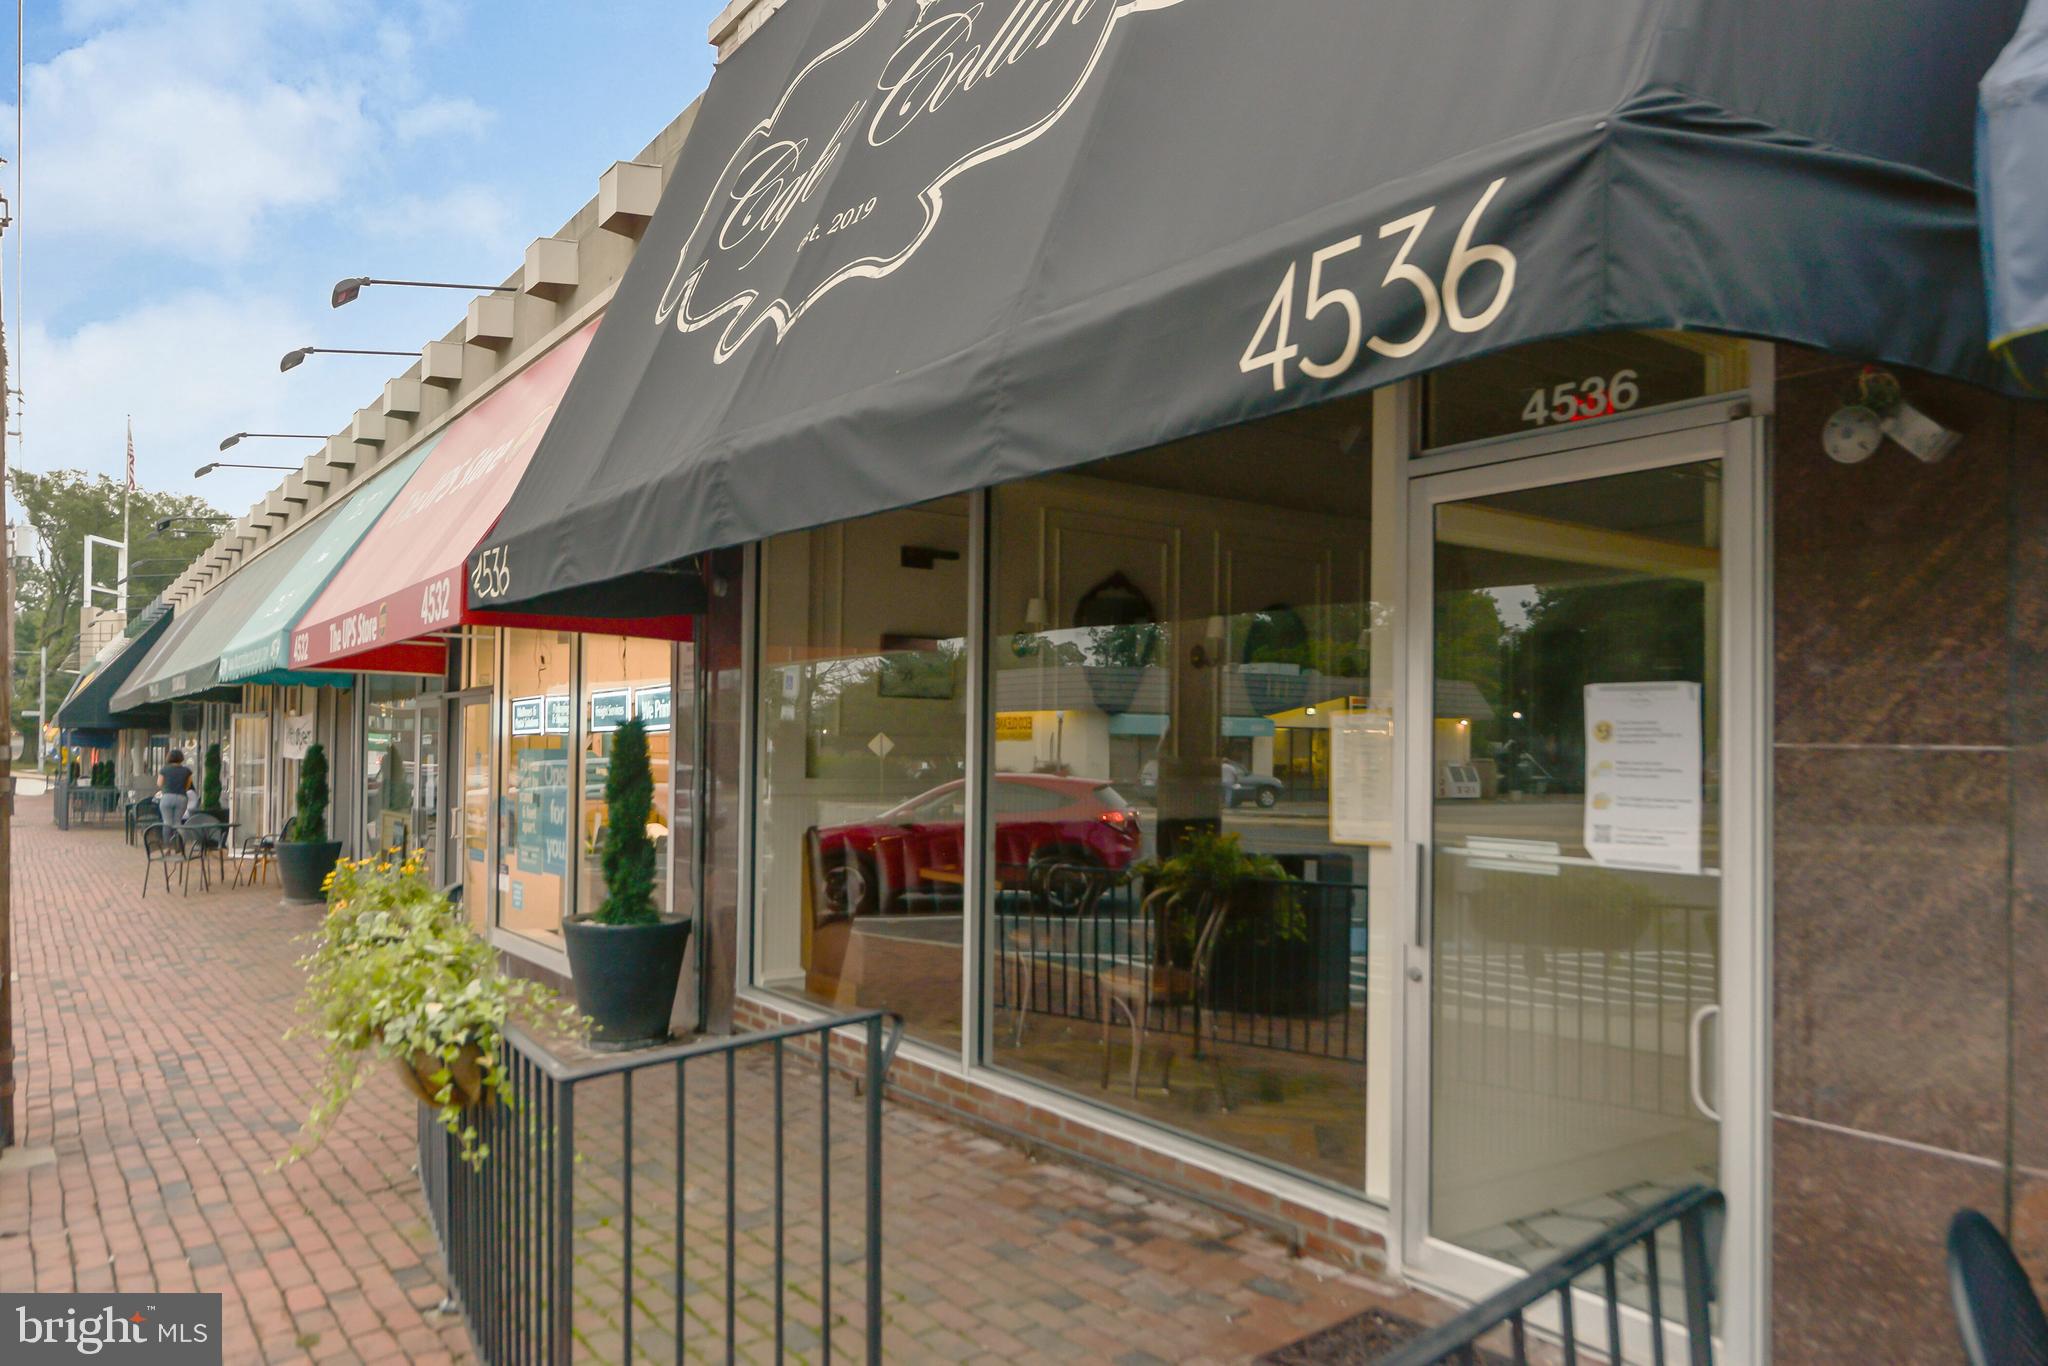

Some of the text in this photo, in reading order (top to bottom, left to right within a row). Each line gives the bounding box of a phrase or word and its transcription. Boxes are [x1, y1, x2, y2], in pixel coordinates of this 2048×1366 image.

[826, 197, 877, 235] 2019
[1239, 177, 1517, 391] 4536
[1521, 369, 1639, 426] 4536
[471, 545, 510, 598] 4536
[420, 577, 450, 625] 4532
[293, 632, 309, 663] 4532
[329, 624, 342, 654] The
[342, 615, 357, 650] UPS
[357, 612, 378, 646] Store
[550, 799, 565, 825] for
